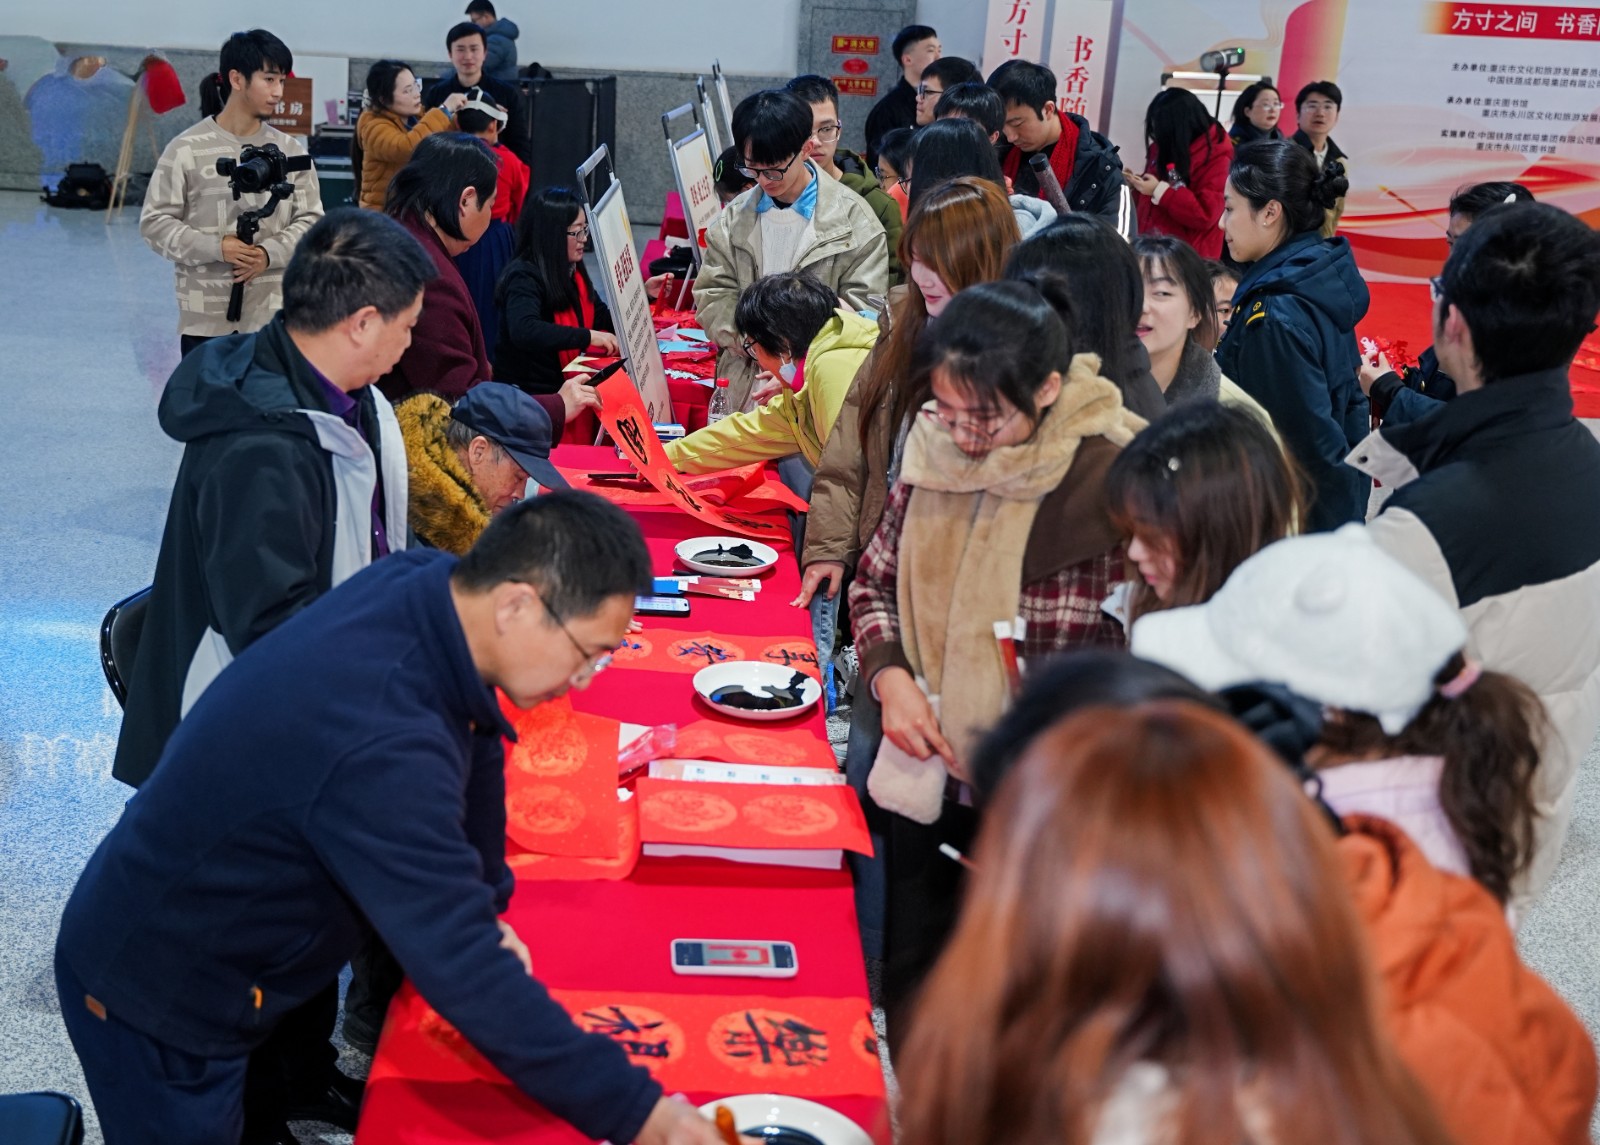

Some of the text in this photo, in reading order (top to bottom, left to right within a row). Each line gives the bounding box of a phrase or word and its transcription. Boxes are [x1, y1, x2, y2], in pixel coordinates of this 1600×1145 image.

[1000, 0, 1031, 56] 方寸
[1452, 8, 1600, 36] 方寸之间 书香
[1451, 63, 1600, 77] 主办单位：重庆市文化和旅游发展委员
[1482, 110, 1600, 122] 重庆市永川区文化和旅游发展
[1476, 143, 1556, 154] 重庆市永川区图书馆
